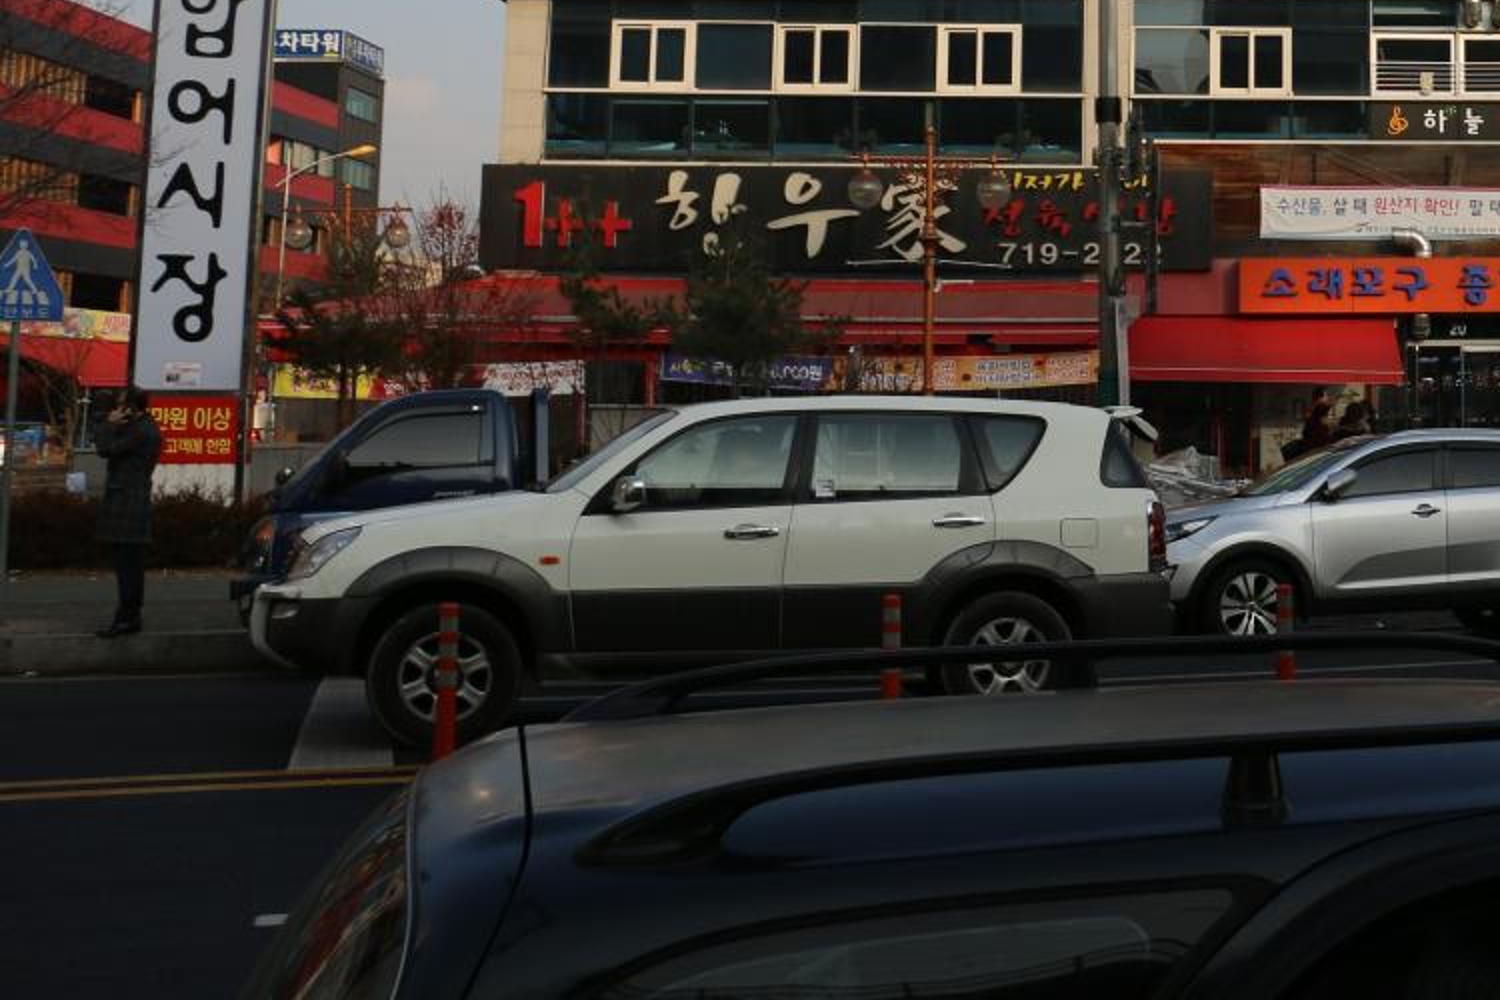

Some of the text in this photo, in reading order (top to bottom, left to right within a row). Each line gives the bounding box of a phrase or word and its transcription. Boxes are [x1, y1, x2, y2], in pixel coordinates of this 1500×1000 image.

[273, 30, 341, 55] 차타워
[513, 181, 632, 248] 1++
[1375, 197, 1418, 217] 원산지
[998, 242, 1161, 265] 719-22
[1261, 266, 1430, 302] 소래포구
[146, 407, 232, 431] 만원 이상
